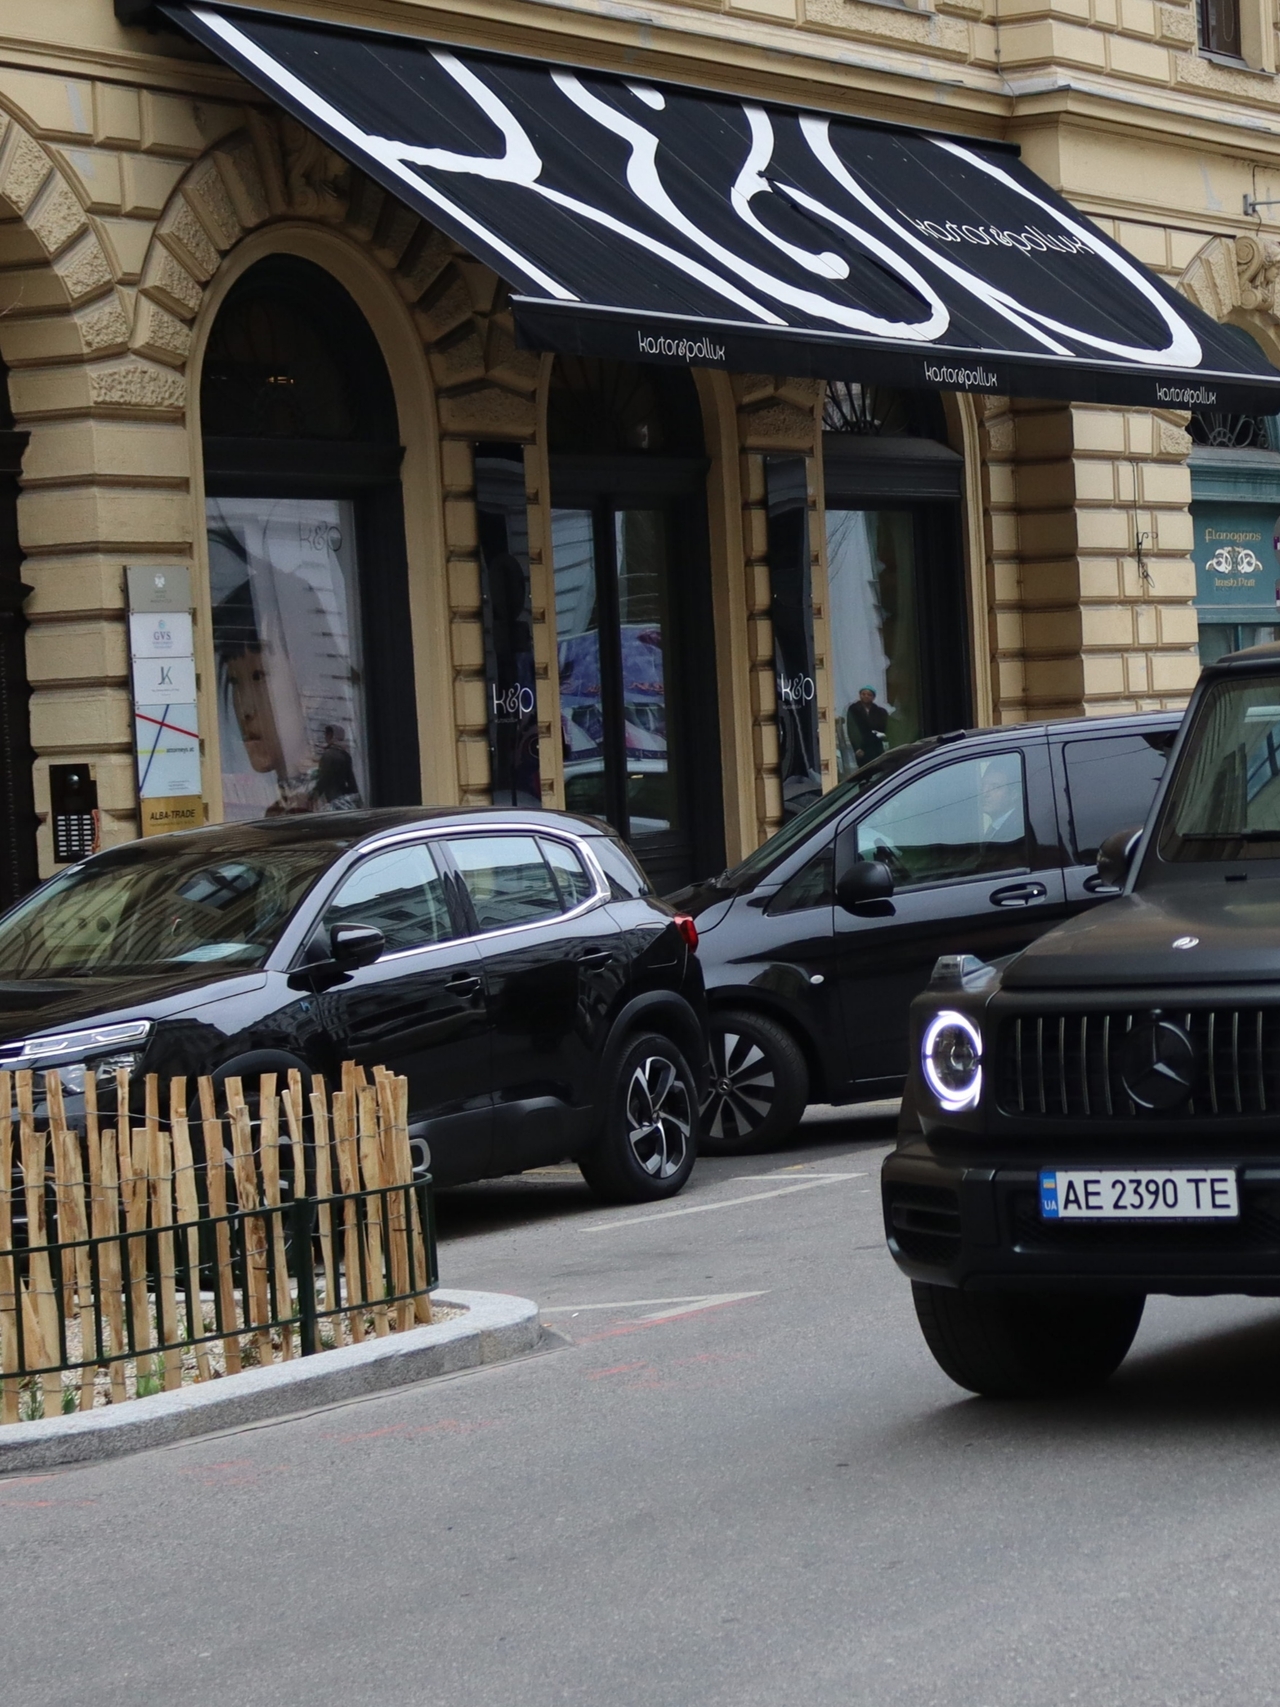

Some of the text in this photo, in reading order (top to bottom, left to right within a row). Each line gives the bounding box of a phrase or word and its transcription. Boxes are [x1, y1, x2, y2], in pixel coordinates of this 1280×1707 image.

[896, 208, 1095, 257] kastor&pollux
[637, 330, 725, 363] kastor&pollux
[924, 360, 998, 390] kastor&pollux
[1155, 382, 1217, 408] kastor&pollux
[153, 631, 172, 641] GVS
[492, 682, 534, 720] k&p
[781, 672, 815, 707] k&p
[149, 809, 196, 821] ALBA-TRADE
[1044, 1177, 1232, 1211] UA AE 2390 TE
